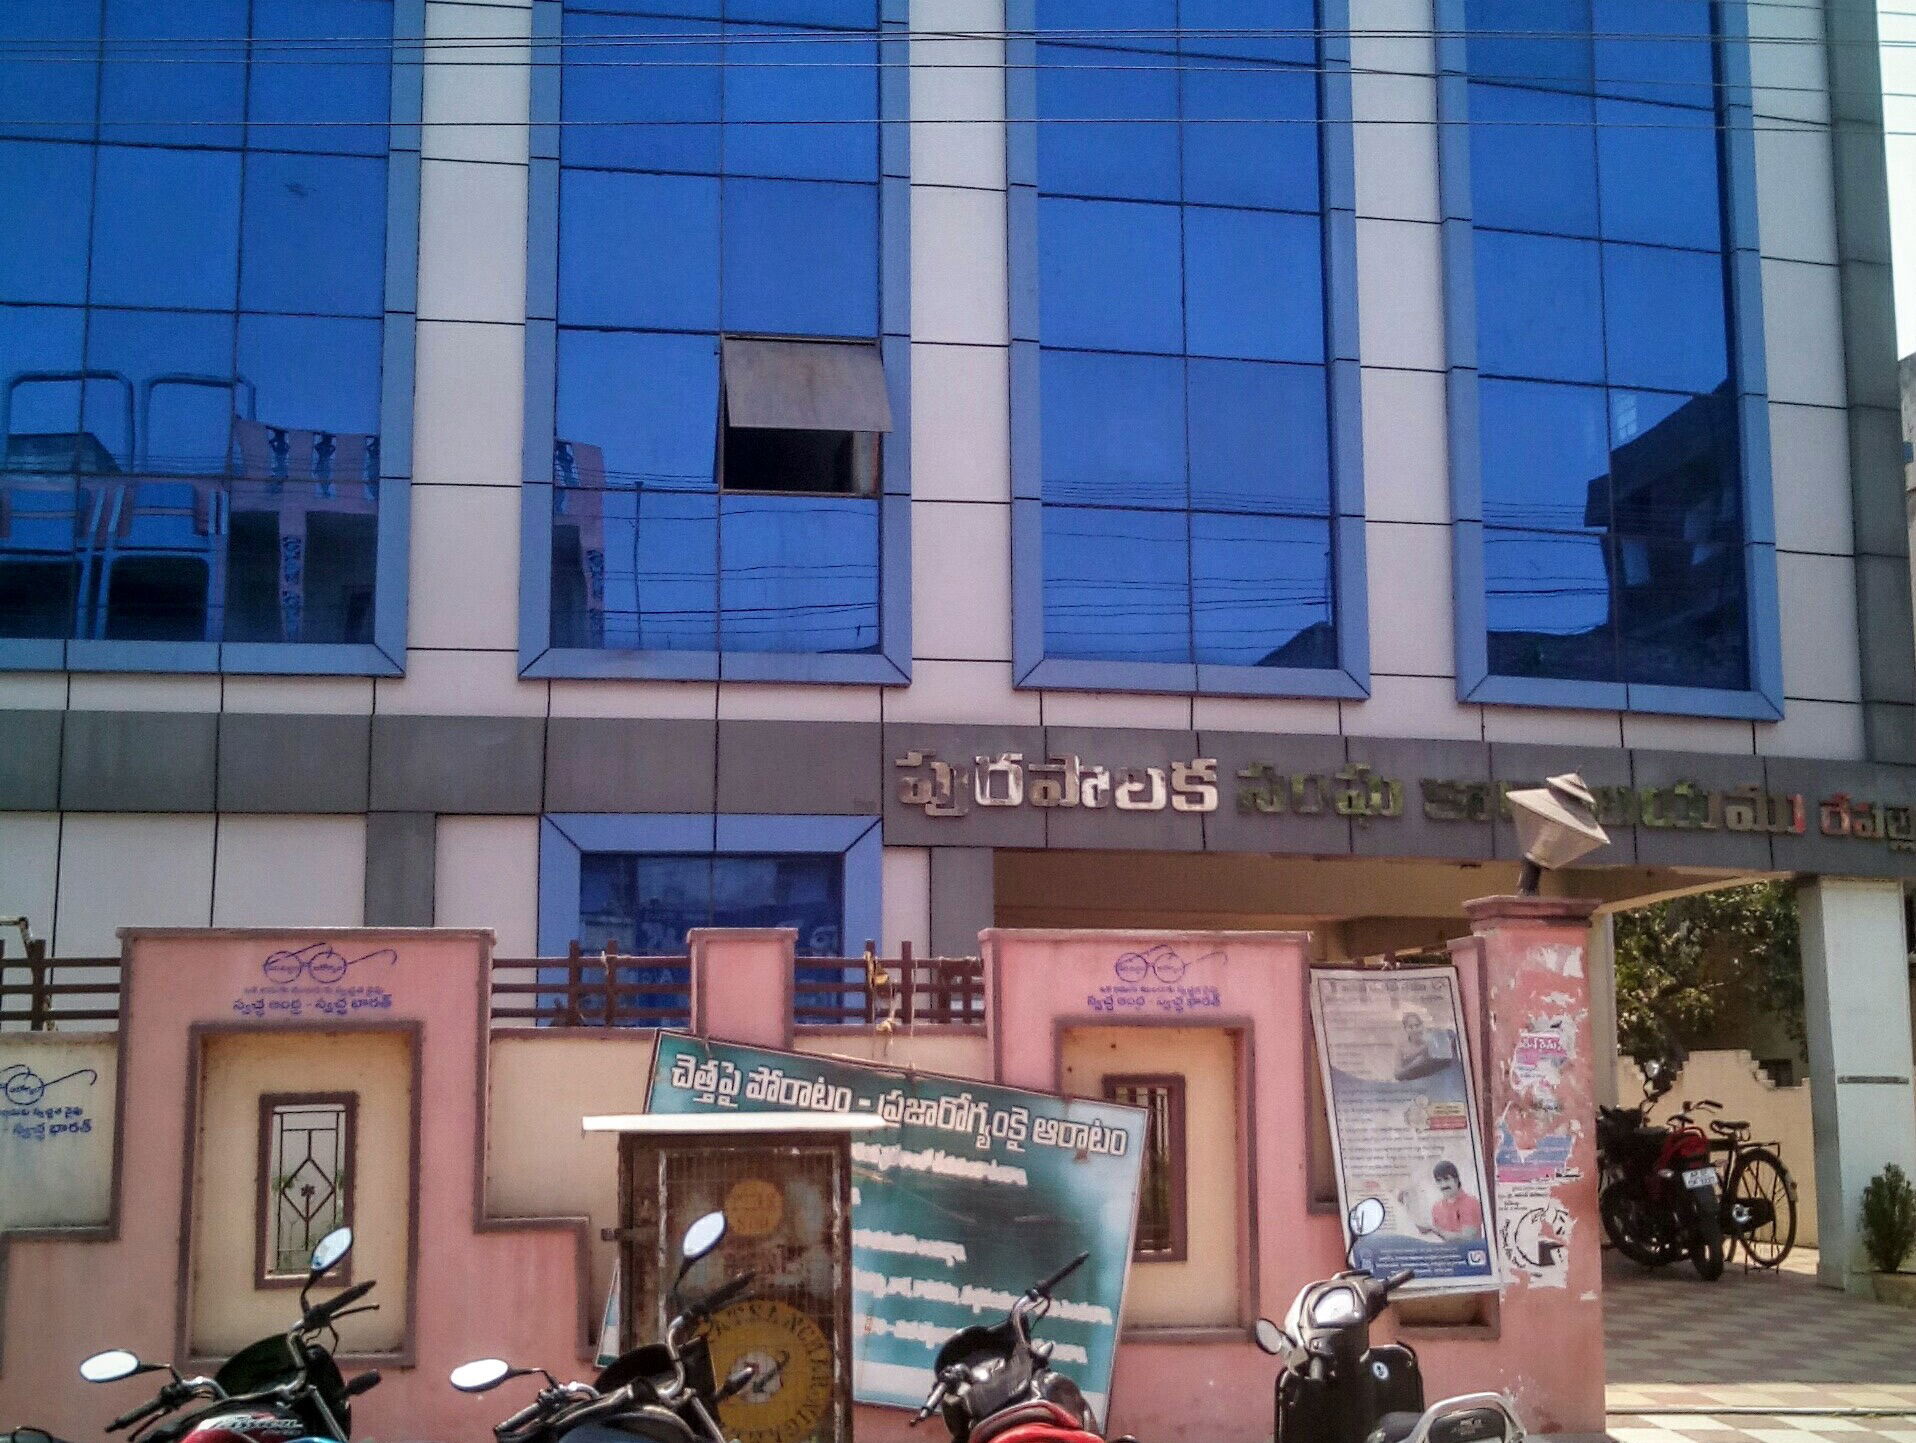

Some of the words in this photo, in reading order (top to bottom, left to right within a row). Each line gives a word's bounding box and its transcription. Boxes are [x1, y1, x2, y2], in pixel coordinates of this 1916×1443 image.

[895, 748, 1220, 817] పురపాలక
[671, 1053, 743, 1108] చెత్తపై
[746, 1066, 852, 1113] పోరాటం
[1032, 1115, 1127, 1156] ఆరాటం
